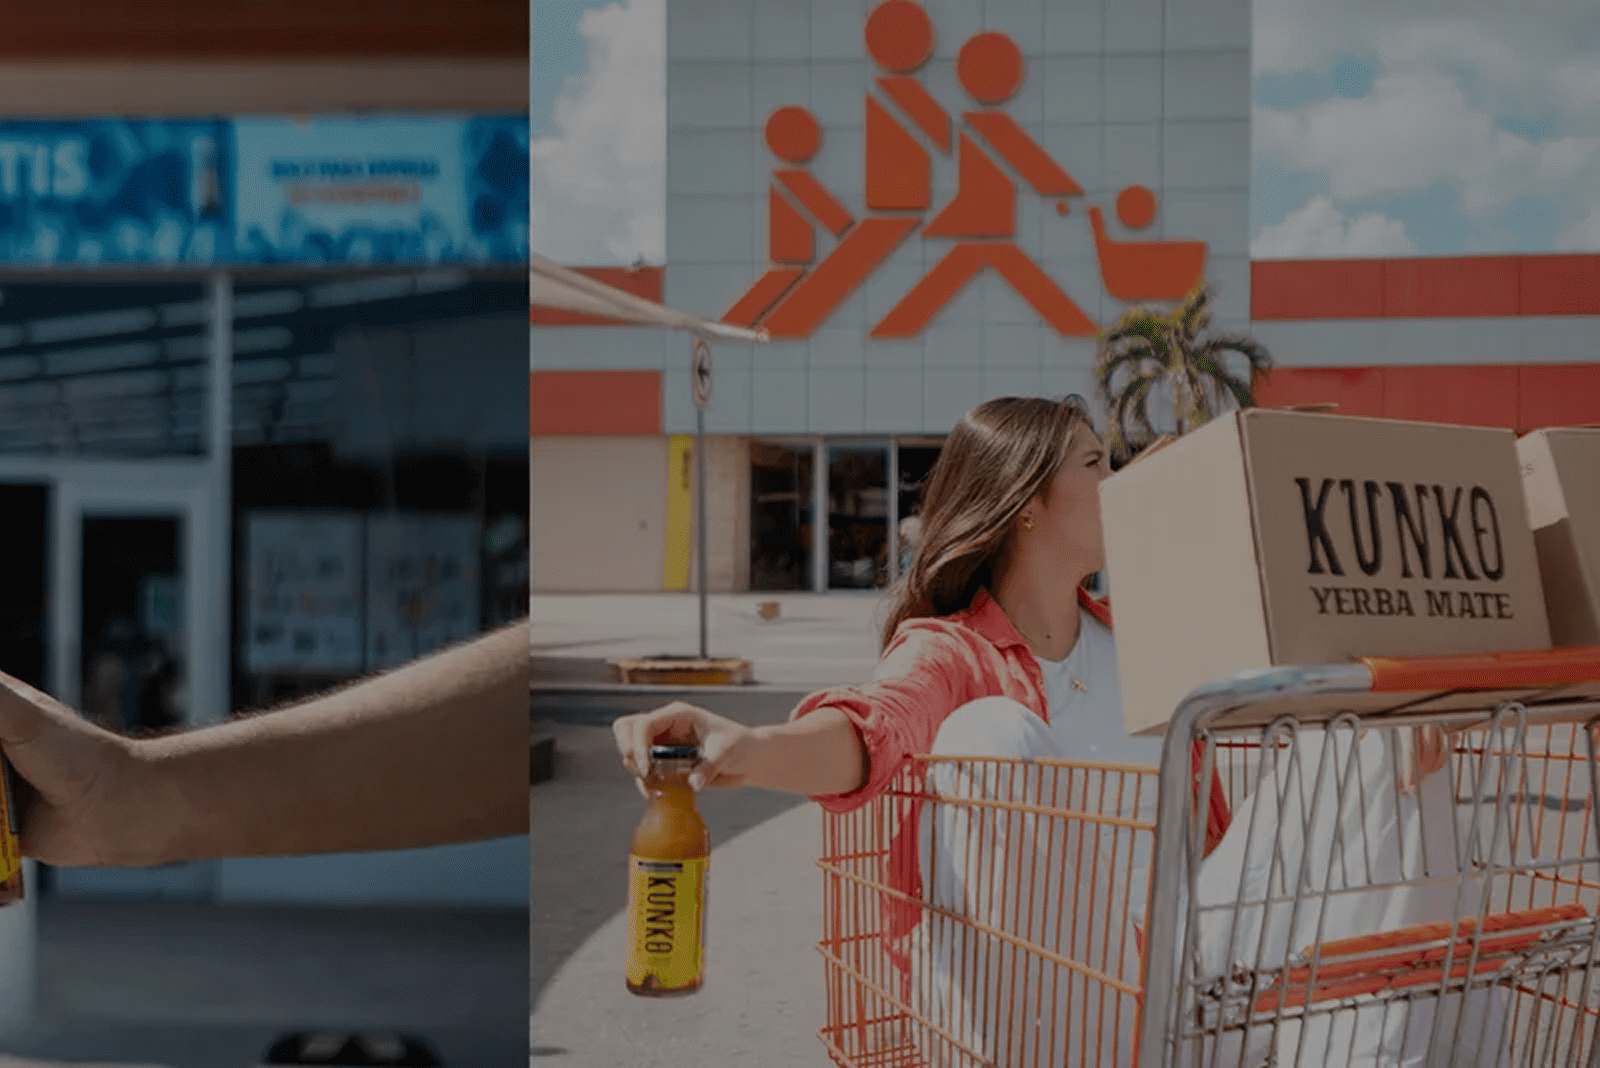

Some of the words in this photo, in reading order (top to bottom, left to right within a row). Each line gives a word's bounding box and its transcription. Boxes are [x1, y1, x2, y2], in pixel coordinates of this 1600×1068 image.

[1294, 476, 1505, 582] KUNKO
[1310, 585, 1416, 617] YERBA
[1423, 588, 1515, 620] MATE
[644, 876, 676, 954] KUNKO
